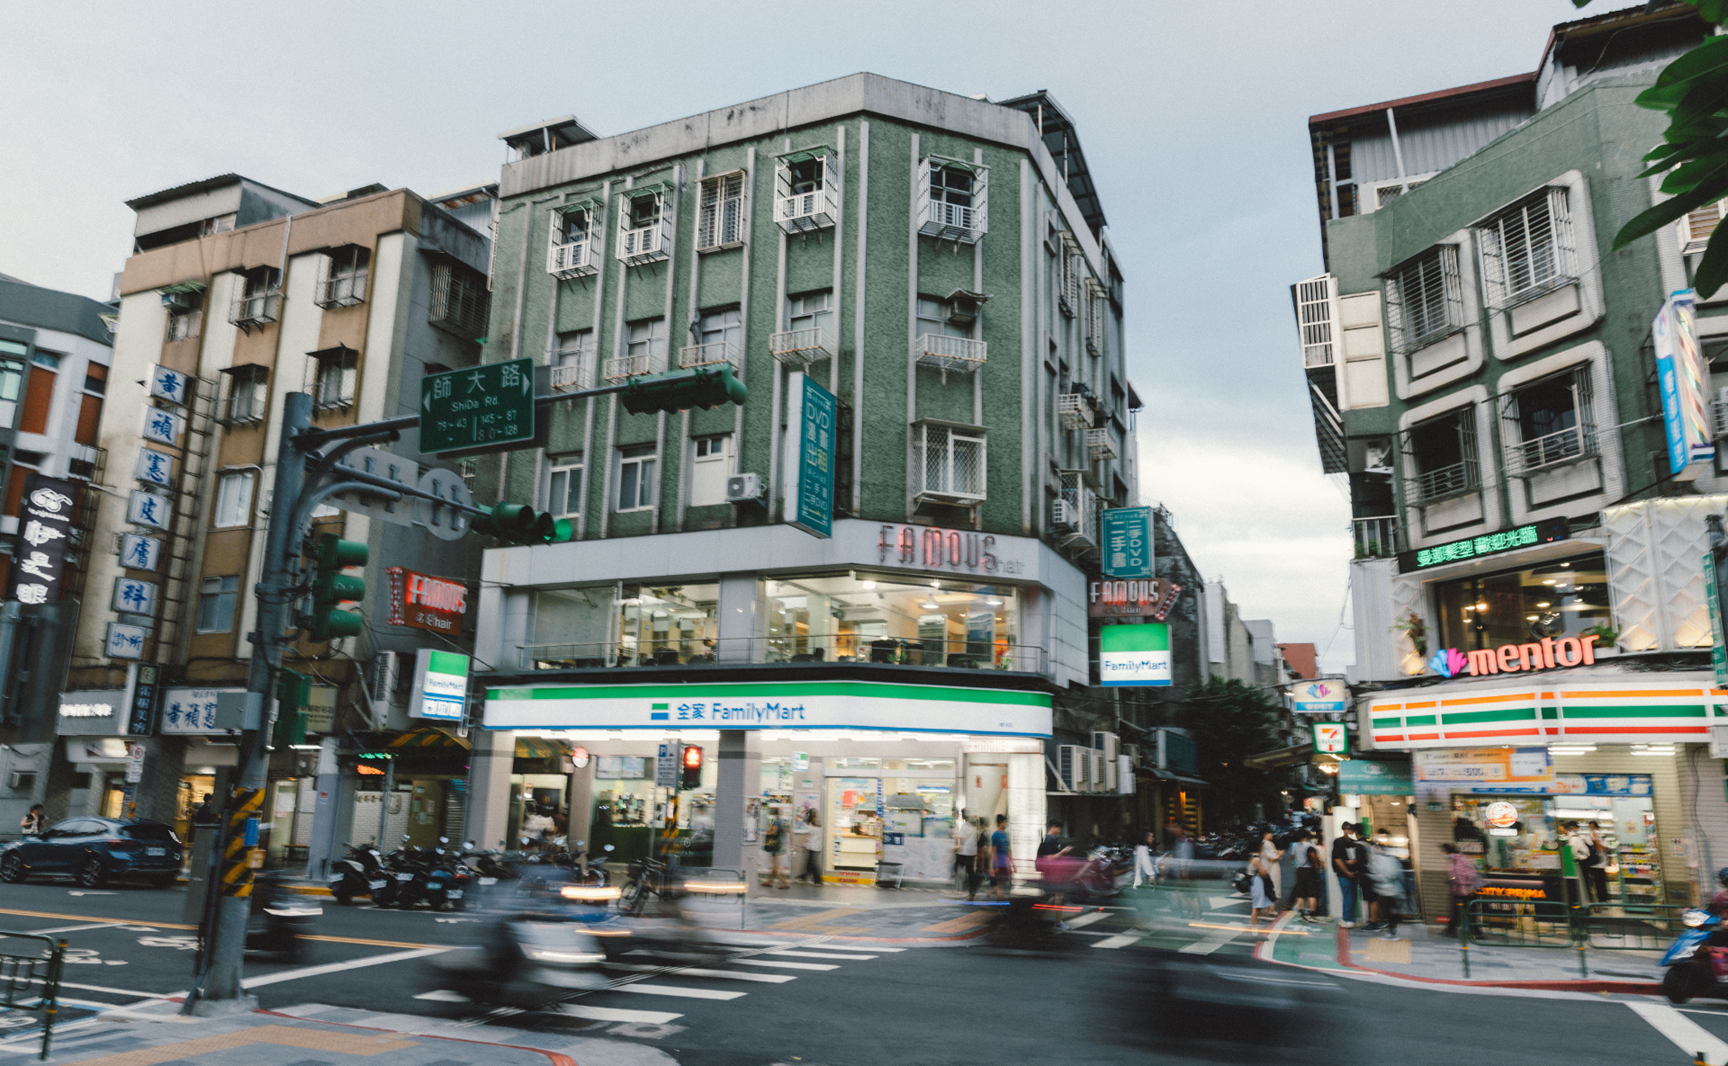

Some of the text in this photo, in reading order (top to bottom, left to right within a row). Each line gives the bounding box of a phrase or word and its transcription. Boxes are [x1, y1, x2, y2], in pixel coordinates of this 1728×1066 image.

[433, 364, 521, 400] 師大路
[451, 396, 500, 412] ShiDa Rd.
[806, 401, 830, 429] DVD
[878, 525, 997, 570] FAMOUS
[410, 574, 469, 615] FAMOUS
[1089, 580, 1159, 603] FAMOUS
[1105, 660, 1168, 674] FamilyMart
[1467, 634, 1600, 676] mentor
[429, 678, 464, 692] FamilyMart
[677, 702, 806, 723] 全家 FamilyMart
